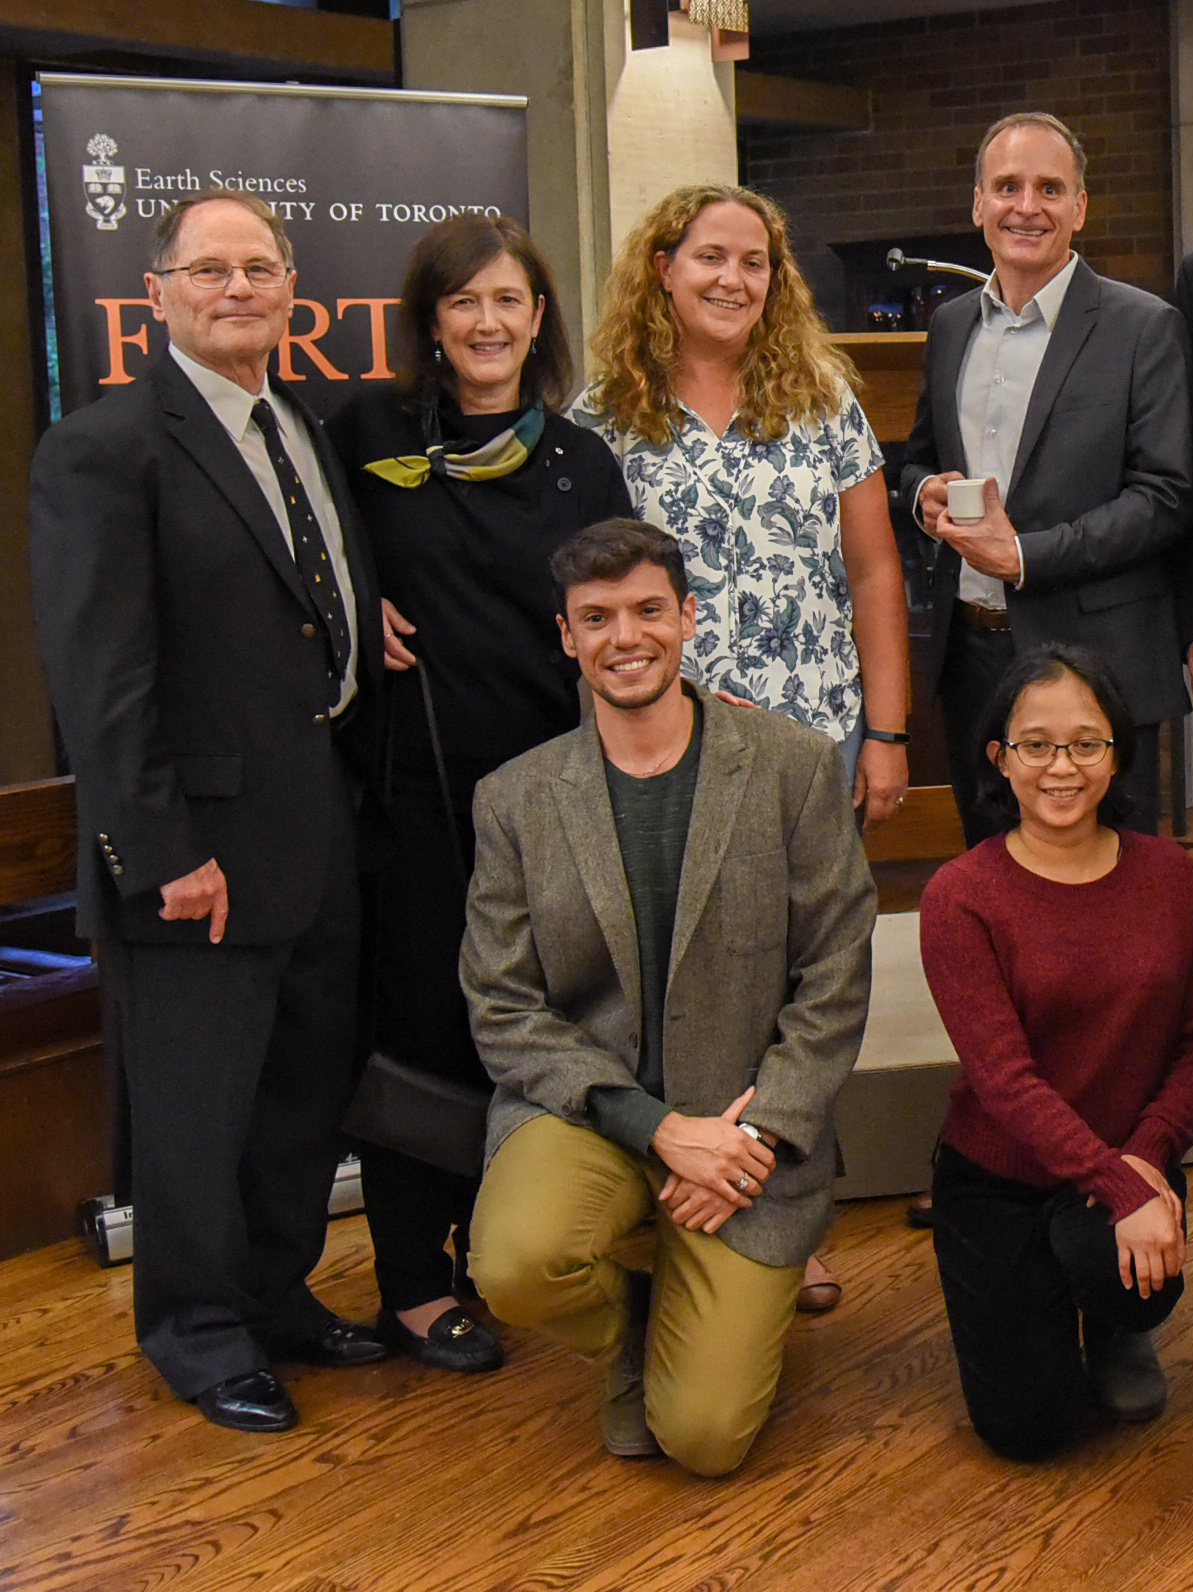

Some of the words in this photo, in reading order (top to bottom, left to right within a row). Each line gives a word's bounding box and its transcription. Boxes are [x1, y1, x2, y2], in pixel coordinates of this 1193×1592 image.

[134, 168, 201, 191] Earth
[209, 169, 307, 193] Sciences
[135, 198, 316, 221] UNITY
[329, 203, 364, 222] OF
